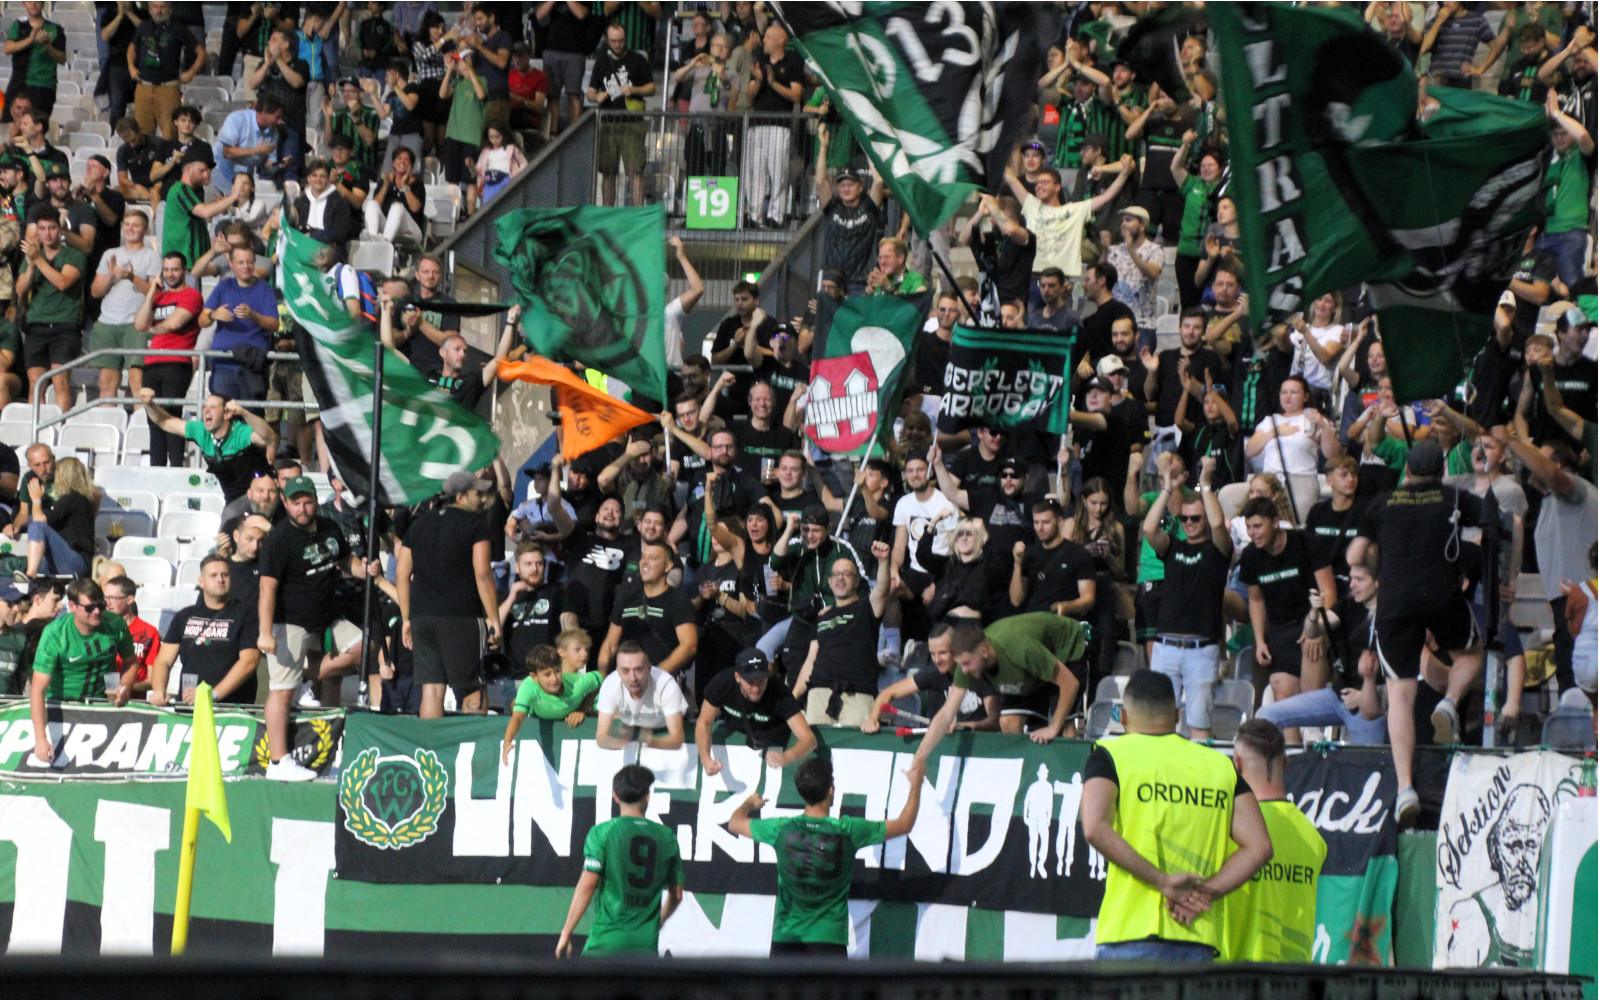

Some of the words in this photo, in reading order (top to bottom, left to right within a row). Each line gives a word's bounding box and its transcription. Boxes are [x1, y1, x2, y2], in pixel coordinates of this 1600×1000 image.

[693, 188, 730, 217] 19
[939, 391, 1054, 419] ARROGA
[453, 735, 1024, 876] UNTERLAND
[1137, 782, 1229, 809] ORDNER
[1287, 770, 1389, 834] ack
[1438, 764, 1512, 890] Sektion
[626, 834, 657, 889] 9
